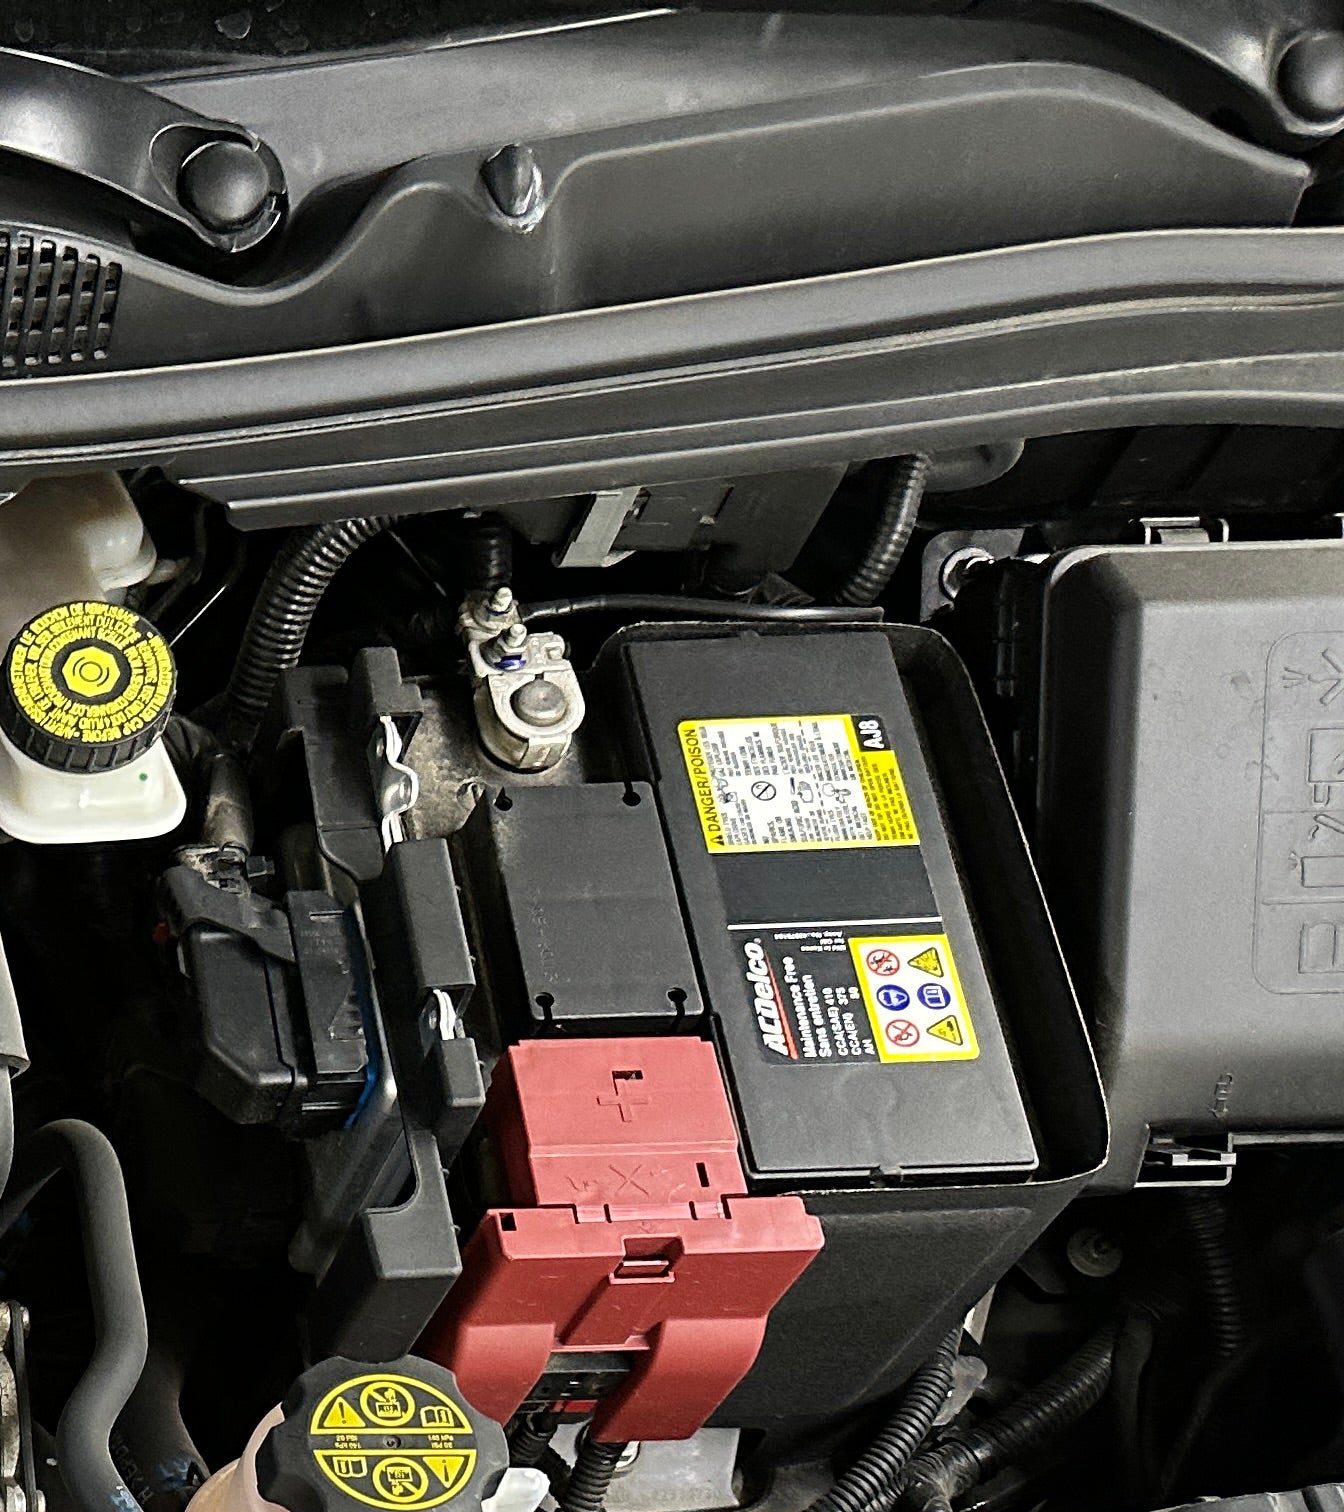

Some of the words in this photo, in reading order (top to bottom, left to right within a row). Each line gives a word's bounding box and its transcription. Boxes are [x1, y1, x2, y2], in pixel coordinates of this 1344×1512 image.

[859, 719, 885, 749] AJ8
[684, 729, 720, 831] DANGER/POISON
[782, 956, 799, 983] Free
[744, 941, 789, 1056] ACDelco
[822, 987, 835, 1006] 410
[790, 984, 818, 1058] Maintenance
[816, 1027, 832, 1058] Sans
